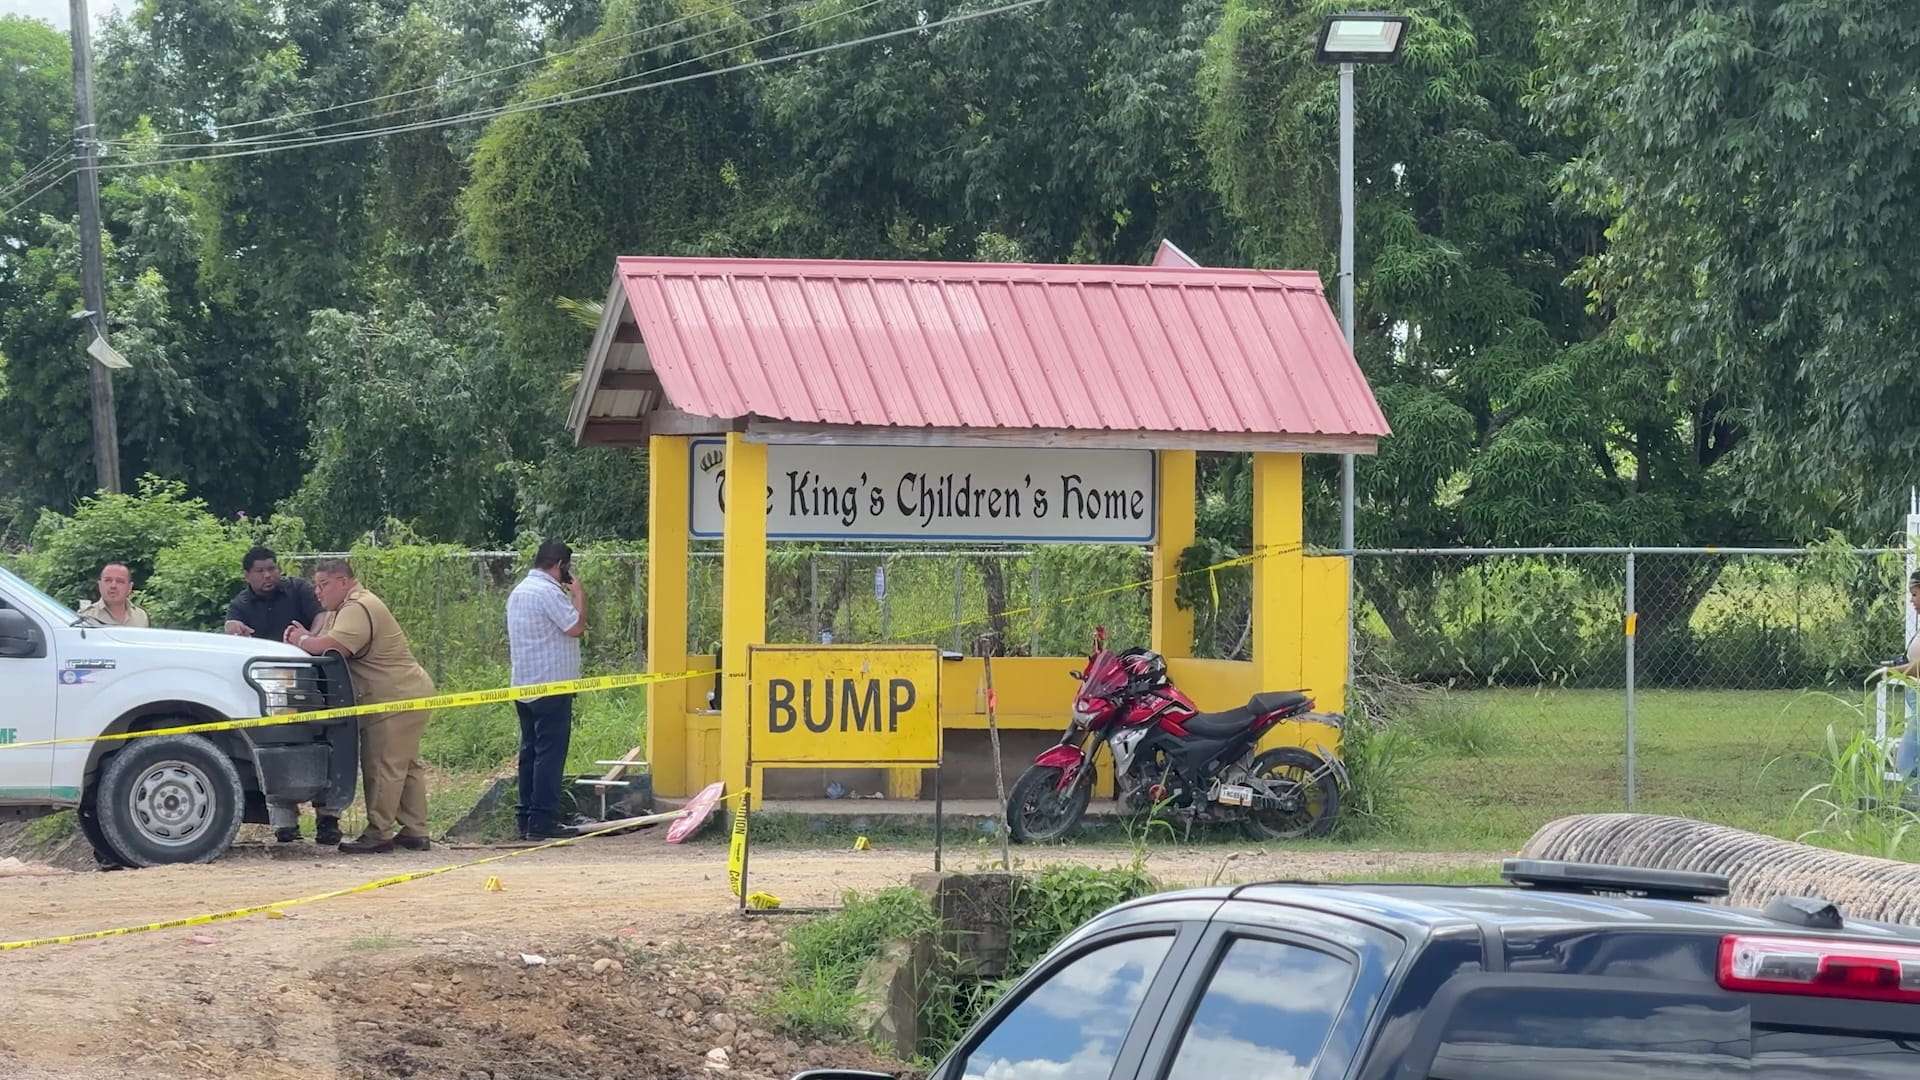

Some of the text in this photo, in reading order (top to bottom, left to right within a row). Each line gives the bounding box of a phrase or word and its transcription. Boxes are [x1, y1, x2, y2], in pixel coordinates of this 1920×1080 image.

[785, 470, 885, 527] King's
[896, 472, 1049, 528] Children's
[1060, 474, 1145, 520] Home
[768, 678, 917, 734] BUMP
